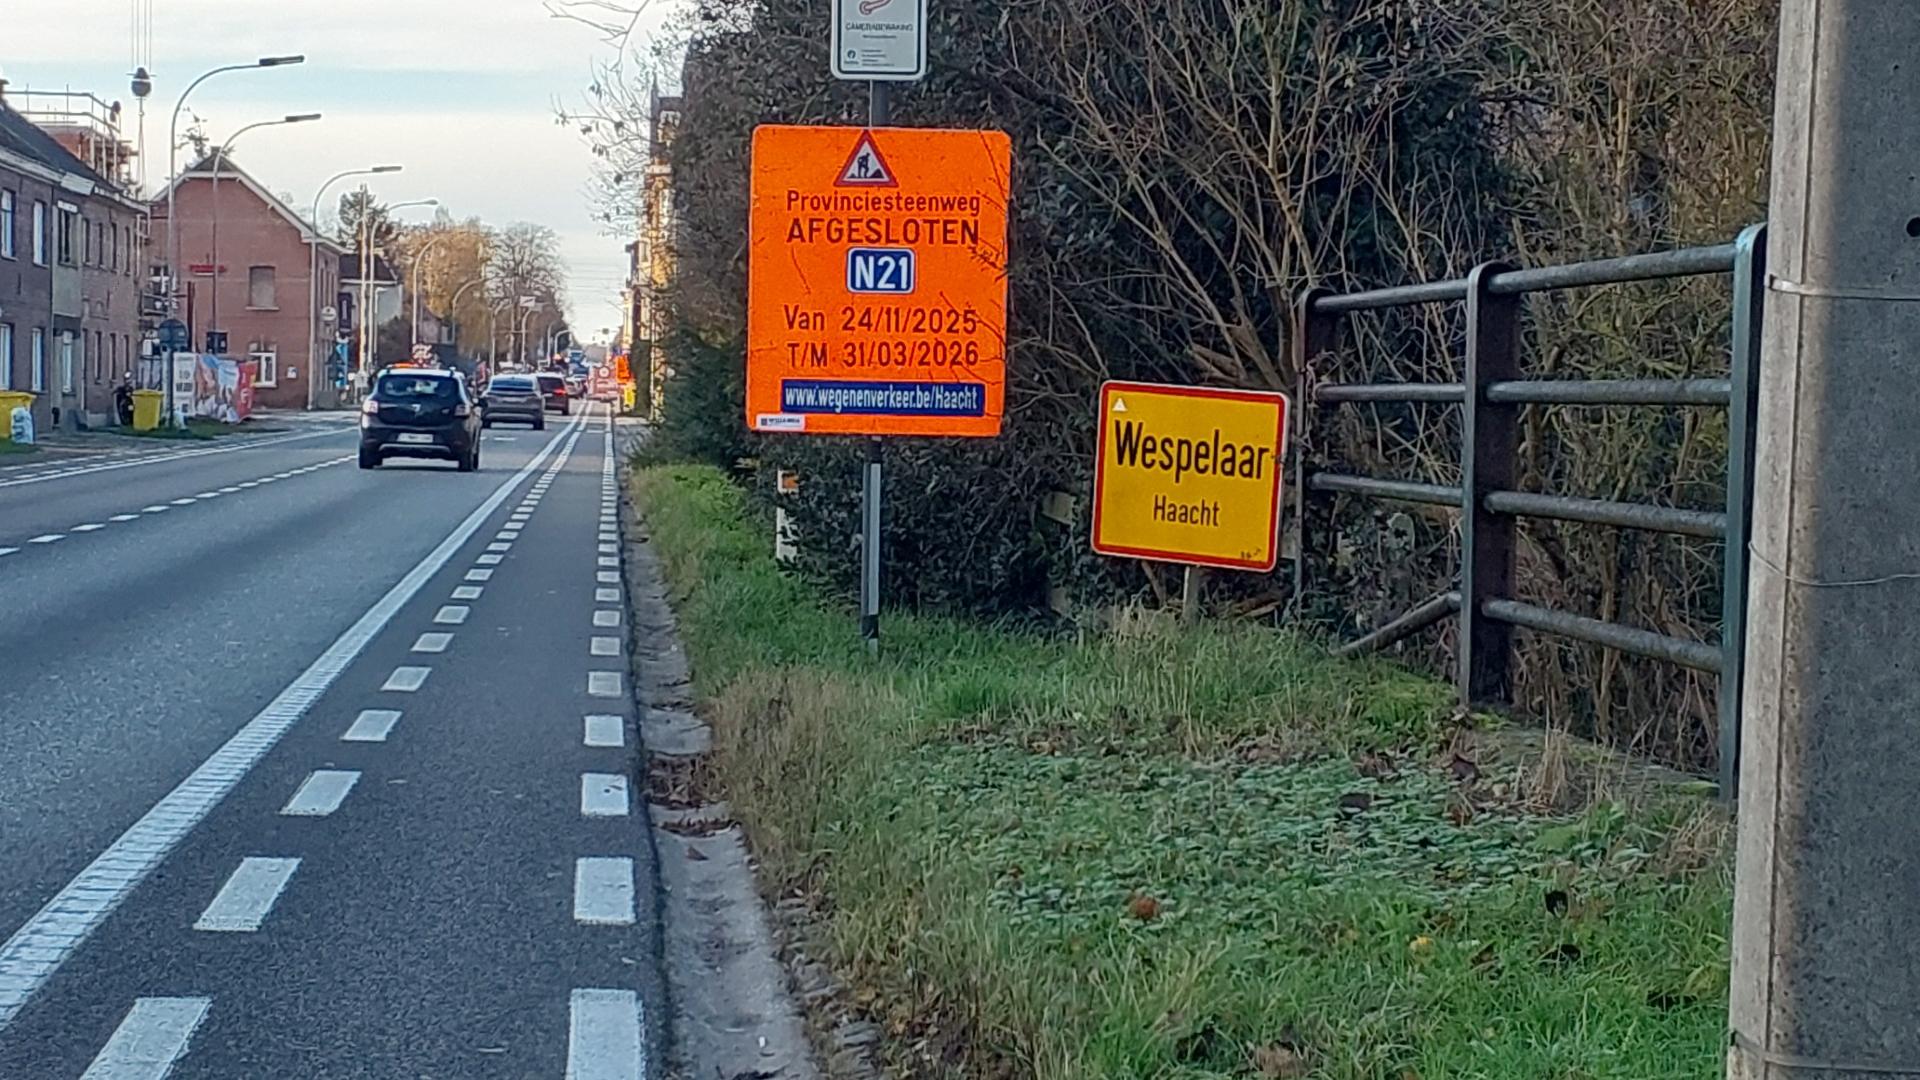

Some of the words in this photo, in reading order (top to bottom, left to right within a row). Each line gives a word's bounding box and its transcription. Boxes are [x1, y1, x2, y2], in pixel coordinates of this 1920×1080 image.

[786, 190, 981, 217] Provinciesteenweg
[786, 217, 980, 246] AFGESLOTEN
[854, 254, 908, 290] N21
[783, 304, 826, 332] Van
[840, 306, 978, 335] 24/11/2025
[787, 342, 829, 368] T/M
[842, 340, 980, 368] 31/03/2026
[785, 385, 978, 414] www.wegenenverkeer.be/Haacht
[1114, 419, 1270, 485] Wespelaar
[1153, 494, 1221, 528] Haacht
